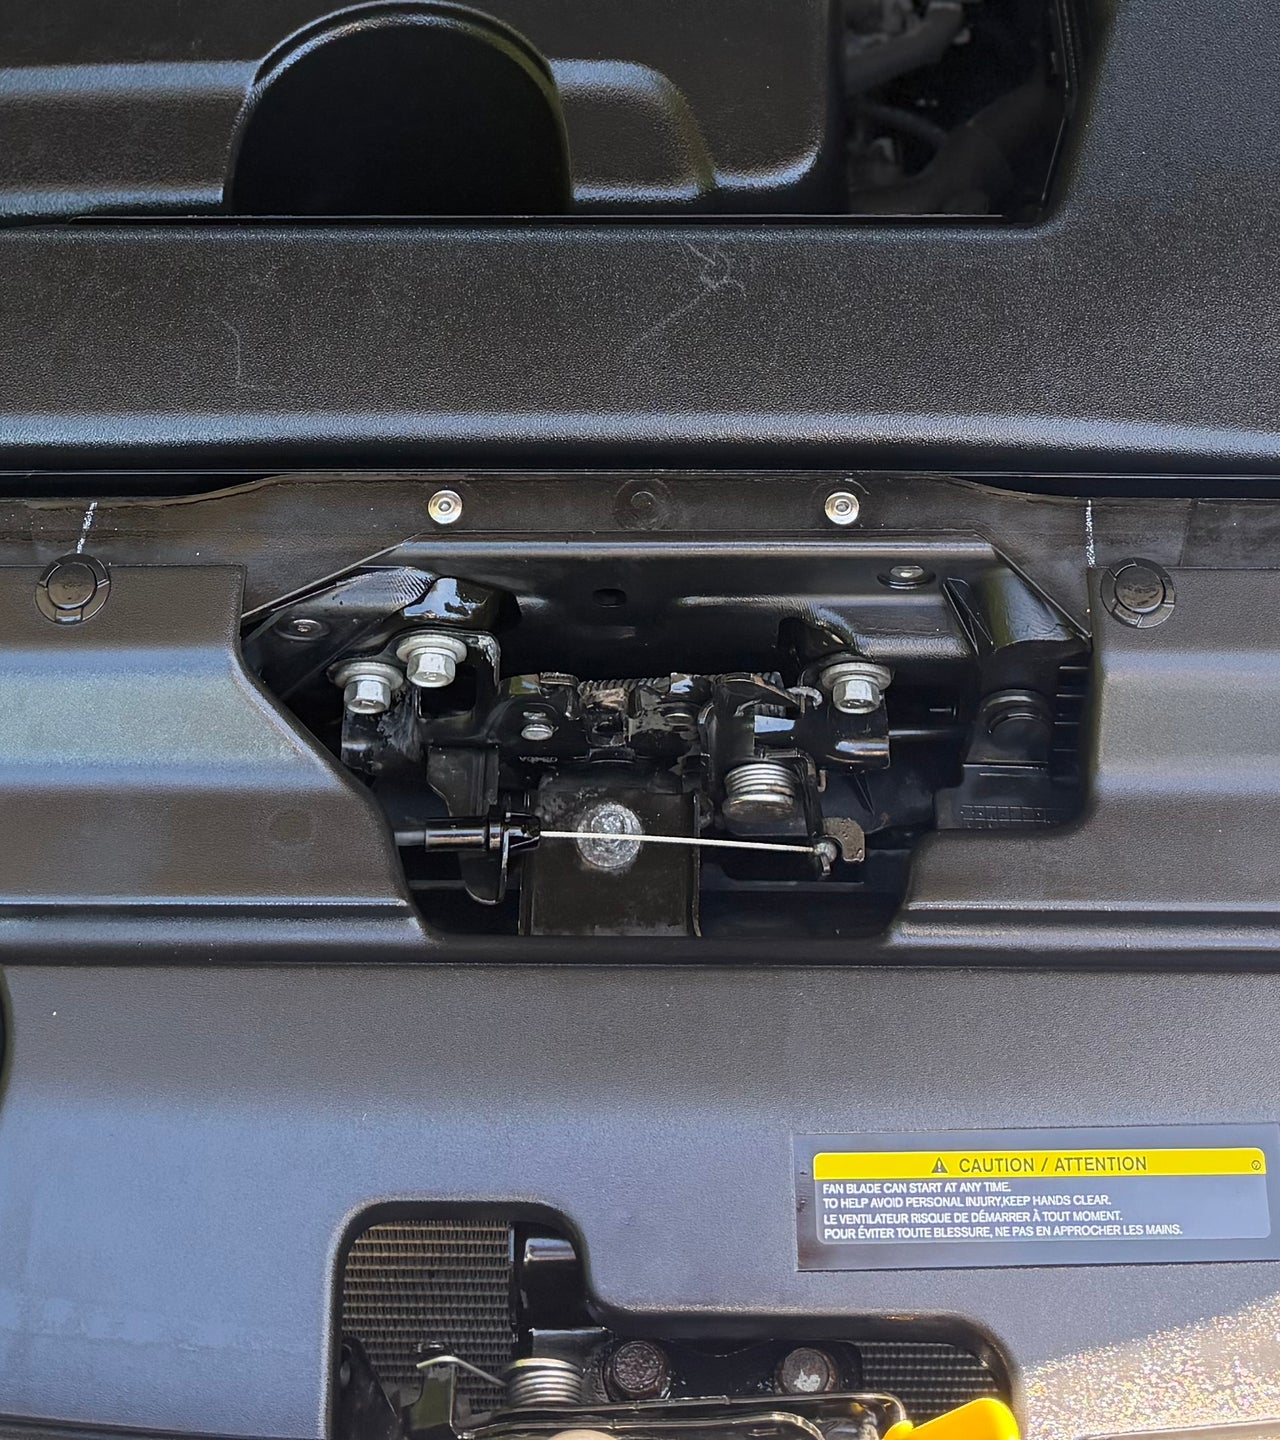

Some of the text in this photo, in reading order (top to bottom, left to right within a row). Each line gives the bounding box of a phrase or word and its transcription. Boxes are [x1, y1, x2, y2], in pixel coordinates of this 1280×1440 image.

[959, 1158, 1034, 1172] CAUTION
[1054, 1156, 1147, 1172] ATTENTION
[823, 1182, 1011, 1194] FAN BLADE CAN START AT ANY TIME.
[823, 1198, 836, 1208] TO
[840, 1198, 868, 1208] HELP
[870, 1197, 903, 1208] AVOID
[906, 1197, 964, 1207] PERSONAL
[1033, 1196, 1070, 1206] HANDS
[1073, 1195, 1111, 1206] CLEAR.
[824, 1209, 1122, 1225] LE VENTILATEUR RISQUE DE DÉMARRER À TOUT MOMENT.
[825, 1224, 1183, 1239] POUR ÉVITER TOUTE BLESSURE, NE PAS EN APPROCHER LES MAINS.
